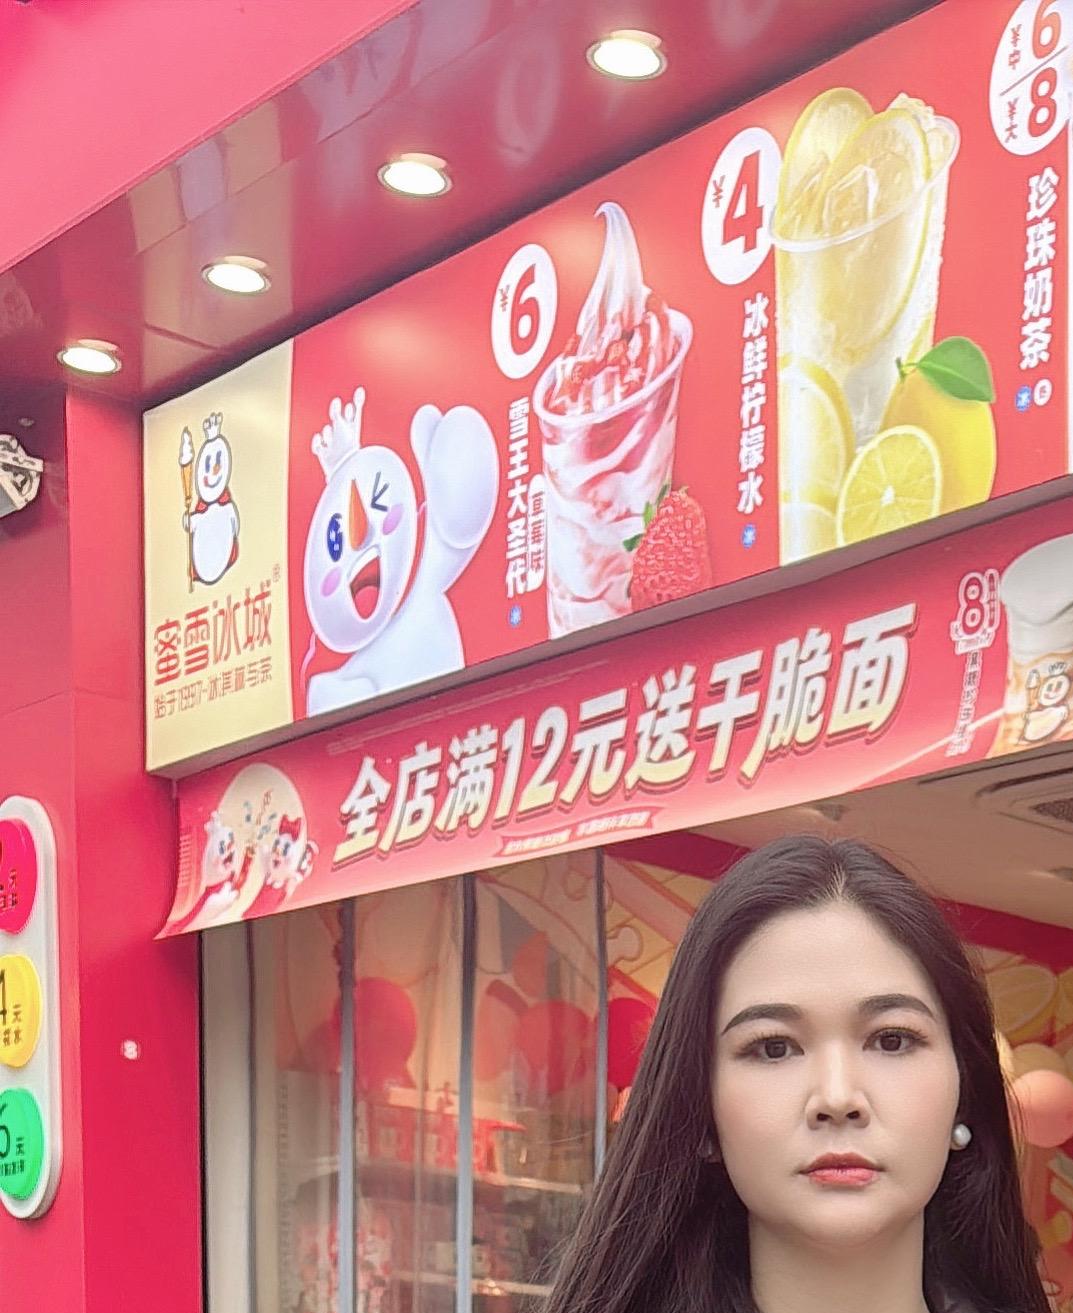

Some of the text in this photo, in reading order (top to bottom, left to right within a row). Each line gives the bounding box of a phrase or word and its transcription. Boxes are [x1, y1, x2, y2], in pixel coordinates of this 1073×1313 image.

[1019, 167, 1060, 370] 珍珠奶茶
[504, 396, 529, 598] 雪王大圣代
[736, 292, 769, 516] 冰鲜柠檬水
[154, 579, 272, 686] 蜜雪冰城
[332, 602, 917, 866] 全店满12元送干脆面
